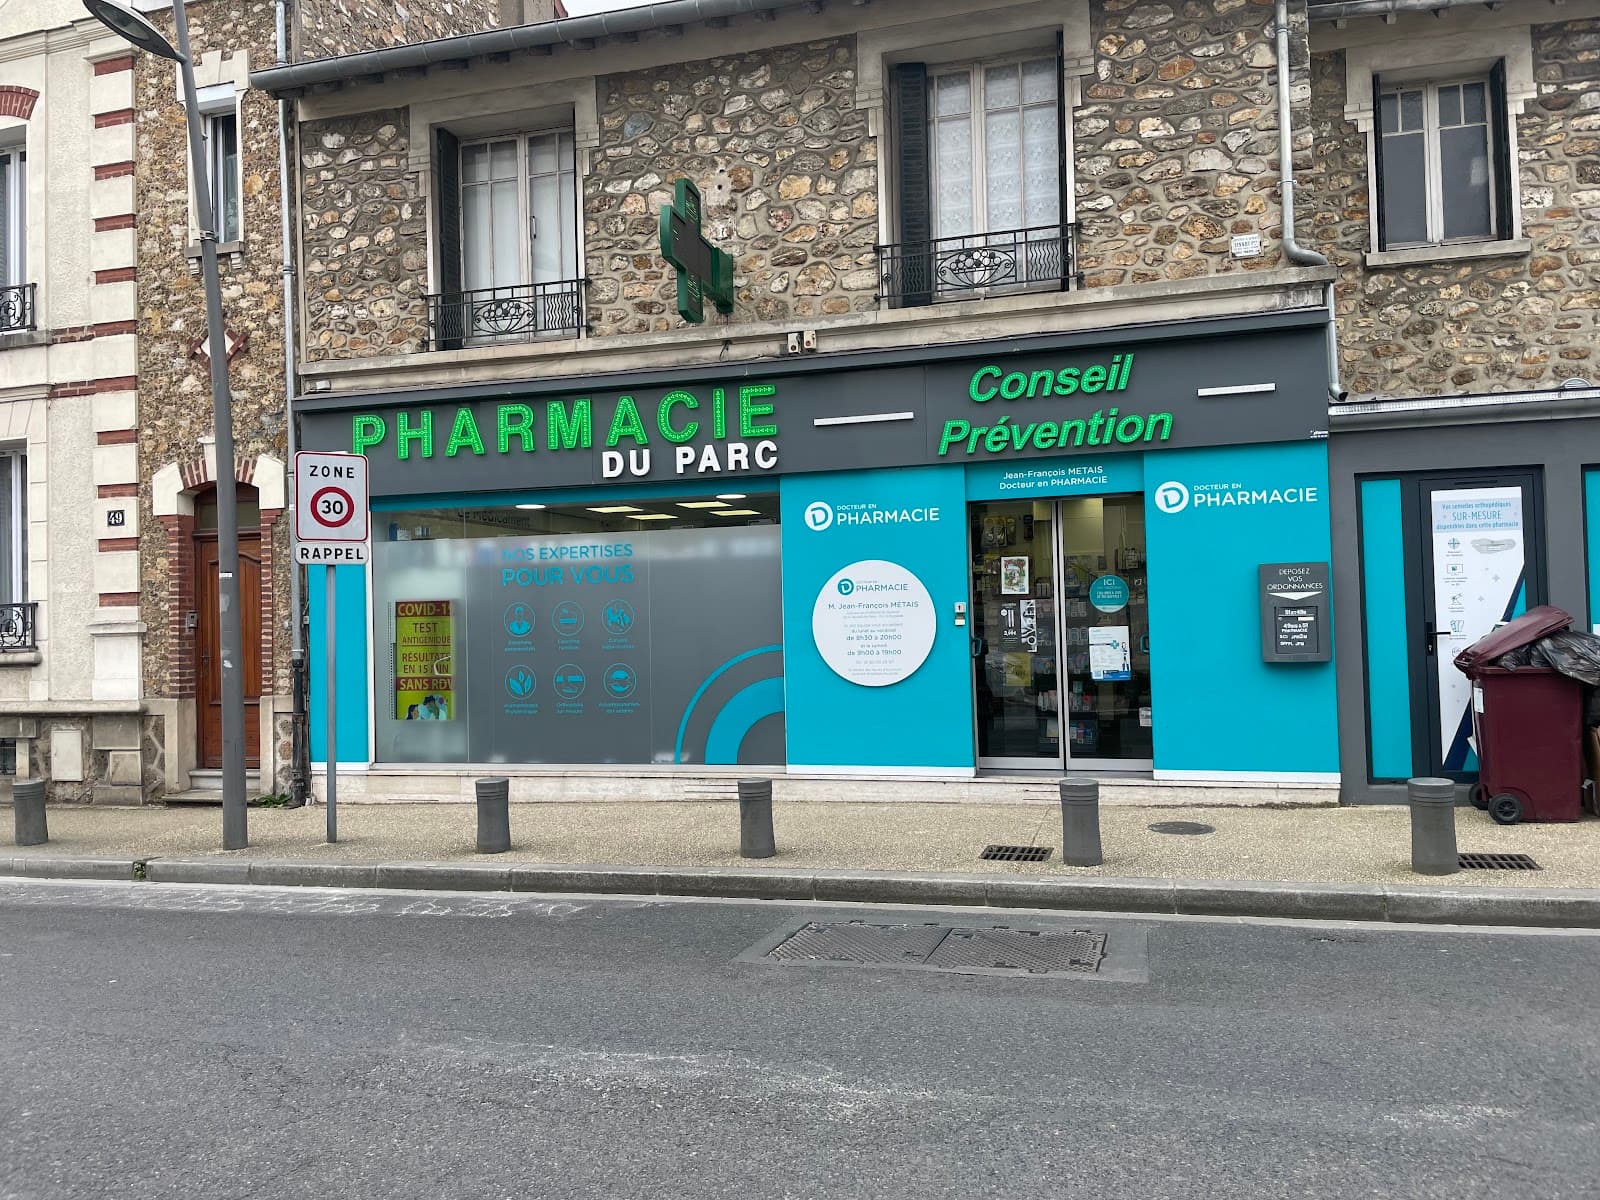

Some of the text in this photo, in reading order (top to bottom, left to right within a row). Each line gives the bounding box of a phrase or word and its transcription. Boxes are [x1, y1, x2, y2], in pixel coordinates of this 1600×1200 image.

[968, 353, 1135, 402] Conseil
[352, 384, 778, 460] PHARMACIE
[937, 407, 1174, 456] Prévention
[602, 440, 779, 478] DU PARC
[309, 465, 355, 479] ZONE
[1003, 465, 1103, 480] Jean-François METAIS
[999, 481, 1035, 490] Docteur
[1051, 476, 1108, 487] PHARMACIE
[1193, 487, 1318, 508] PHARMACIE
[321, 499, 344, 515] 30
[109, 511, 123, 525] 49
[837, 507, 940, 526] PHARMACIE
[1451, 510, 1502, 521] SUR-MESURE
[300, 547, 364, 560] RAPPEL
[502, 544, 633, 561] NOS EXPERTISES
[502, 563, 635, 587] POUR VOUS
[856, 583, 909, 592] PHARMACIE
[1266, 582, 1323, 591] ORDONNANCES
[838, 602, 888, 610] Jean-François
[413, 622, 438, 633] TEST
[403, 664, 415, 674] EN
[419, 664, 428, 674] 15
[399, 678, 454, 690] SANS RDV
